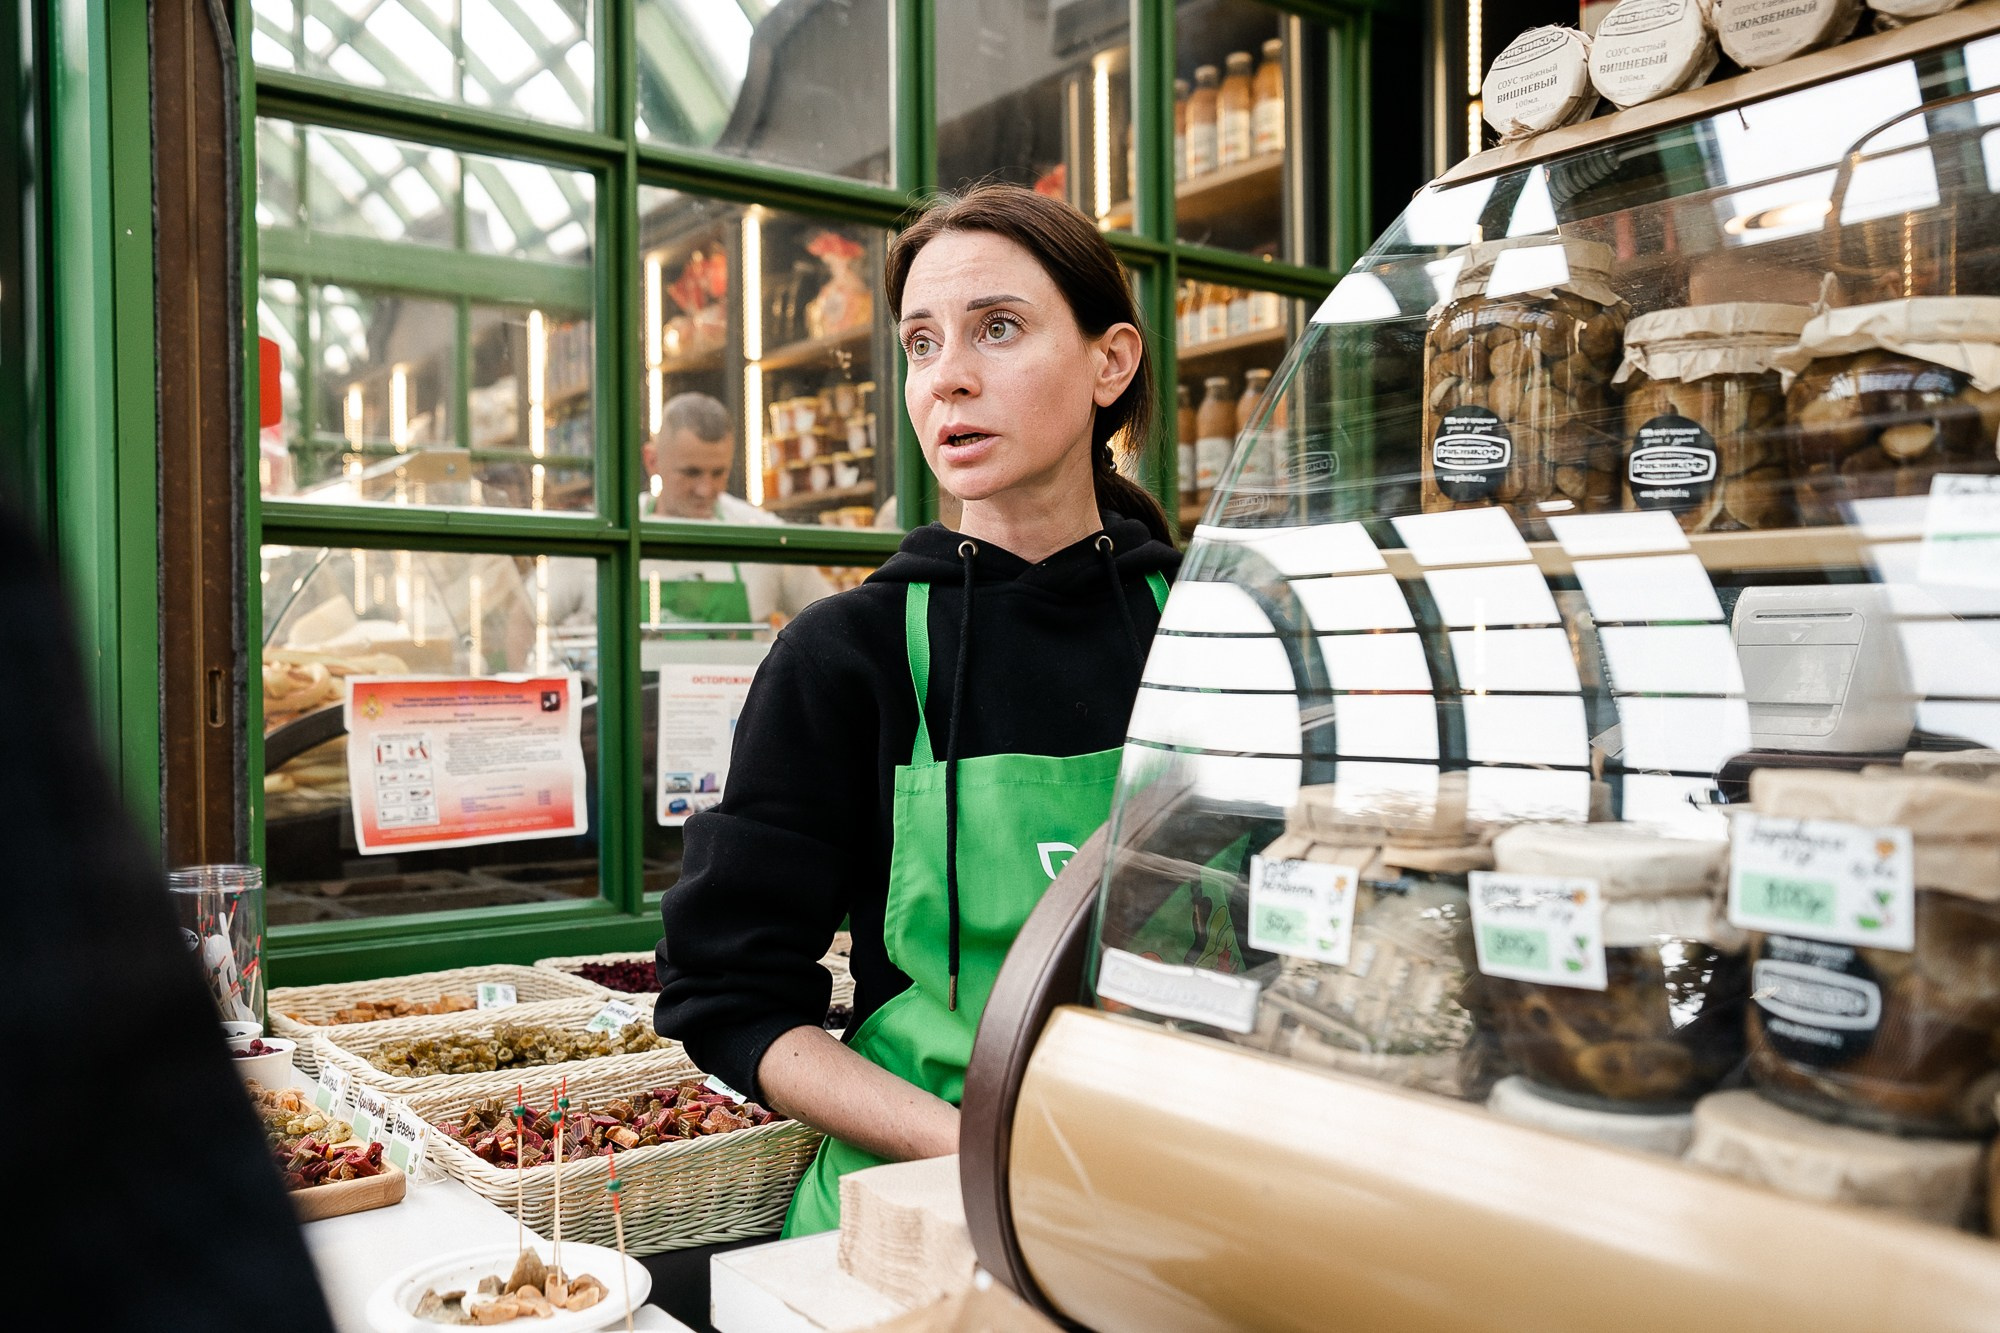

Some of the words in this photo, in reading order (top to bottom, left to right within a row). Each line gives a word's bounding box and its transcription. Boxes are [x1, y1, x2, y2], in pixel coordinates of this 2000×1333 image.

[1605, 46, 1631, 59] СОУС
[1631, 40, 1668, 54] острый
[1600, 52, 1668, 74] ВИШНЕВЫЙ
[1497, 76, 1519, 91] СОУС
[1520, 63, 1559, 82] таёжный
[1497, 74, 1558, 104] ВИШНЕВЫЙ
